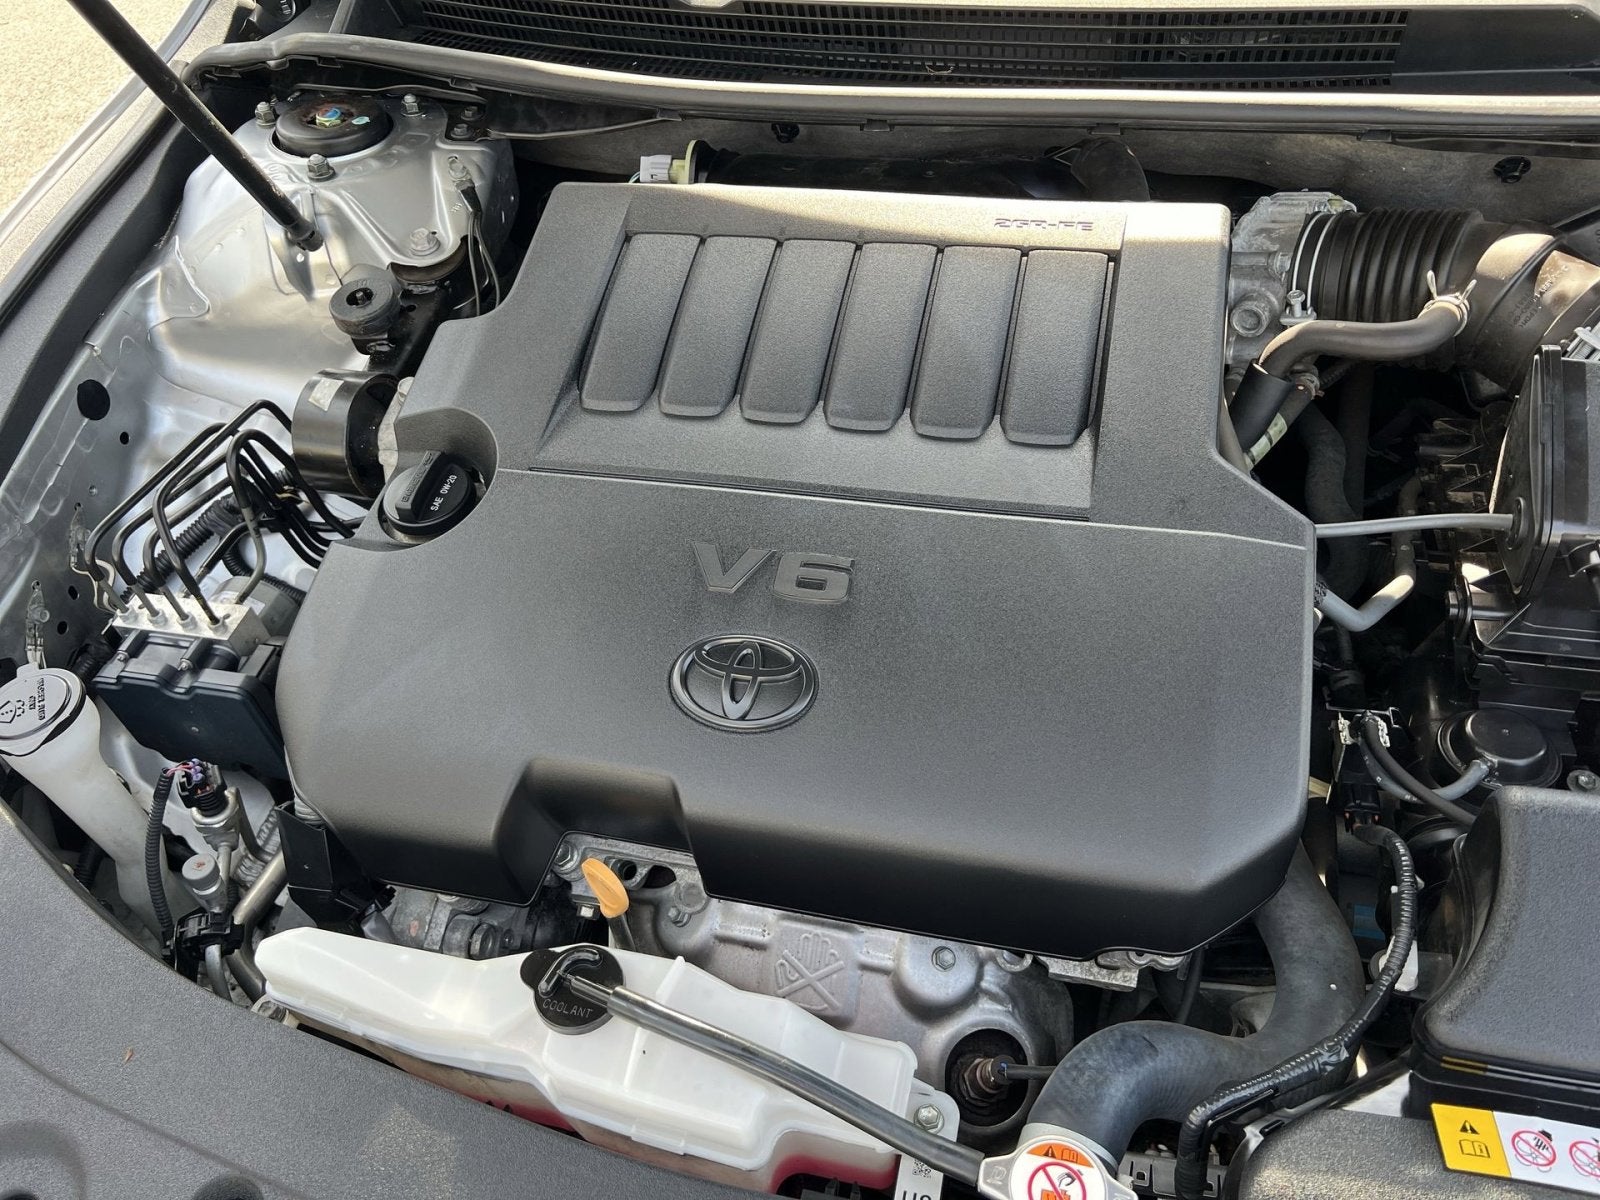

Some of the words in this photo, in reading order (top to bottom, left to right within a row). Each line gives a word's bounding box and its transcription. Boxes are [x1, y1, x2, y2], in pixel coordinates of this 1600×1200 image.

[430, 496, 444, 512] SAE
[440, 474, 458, 495] 0W-20
[690, 541, 855, 604] V6
[543, 998, 593, 1018] COOLANT
